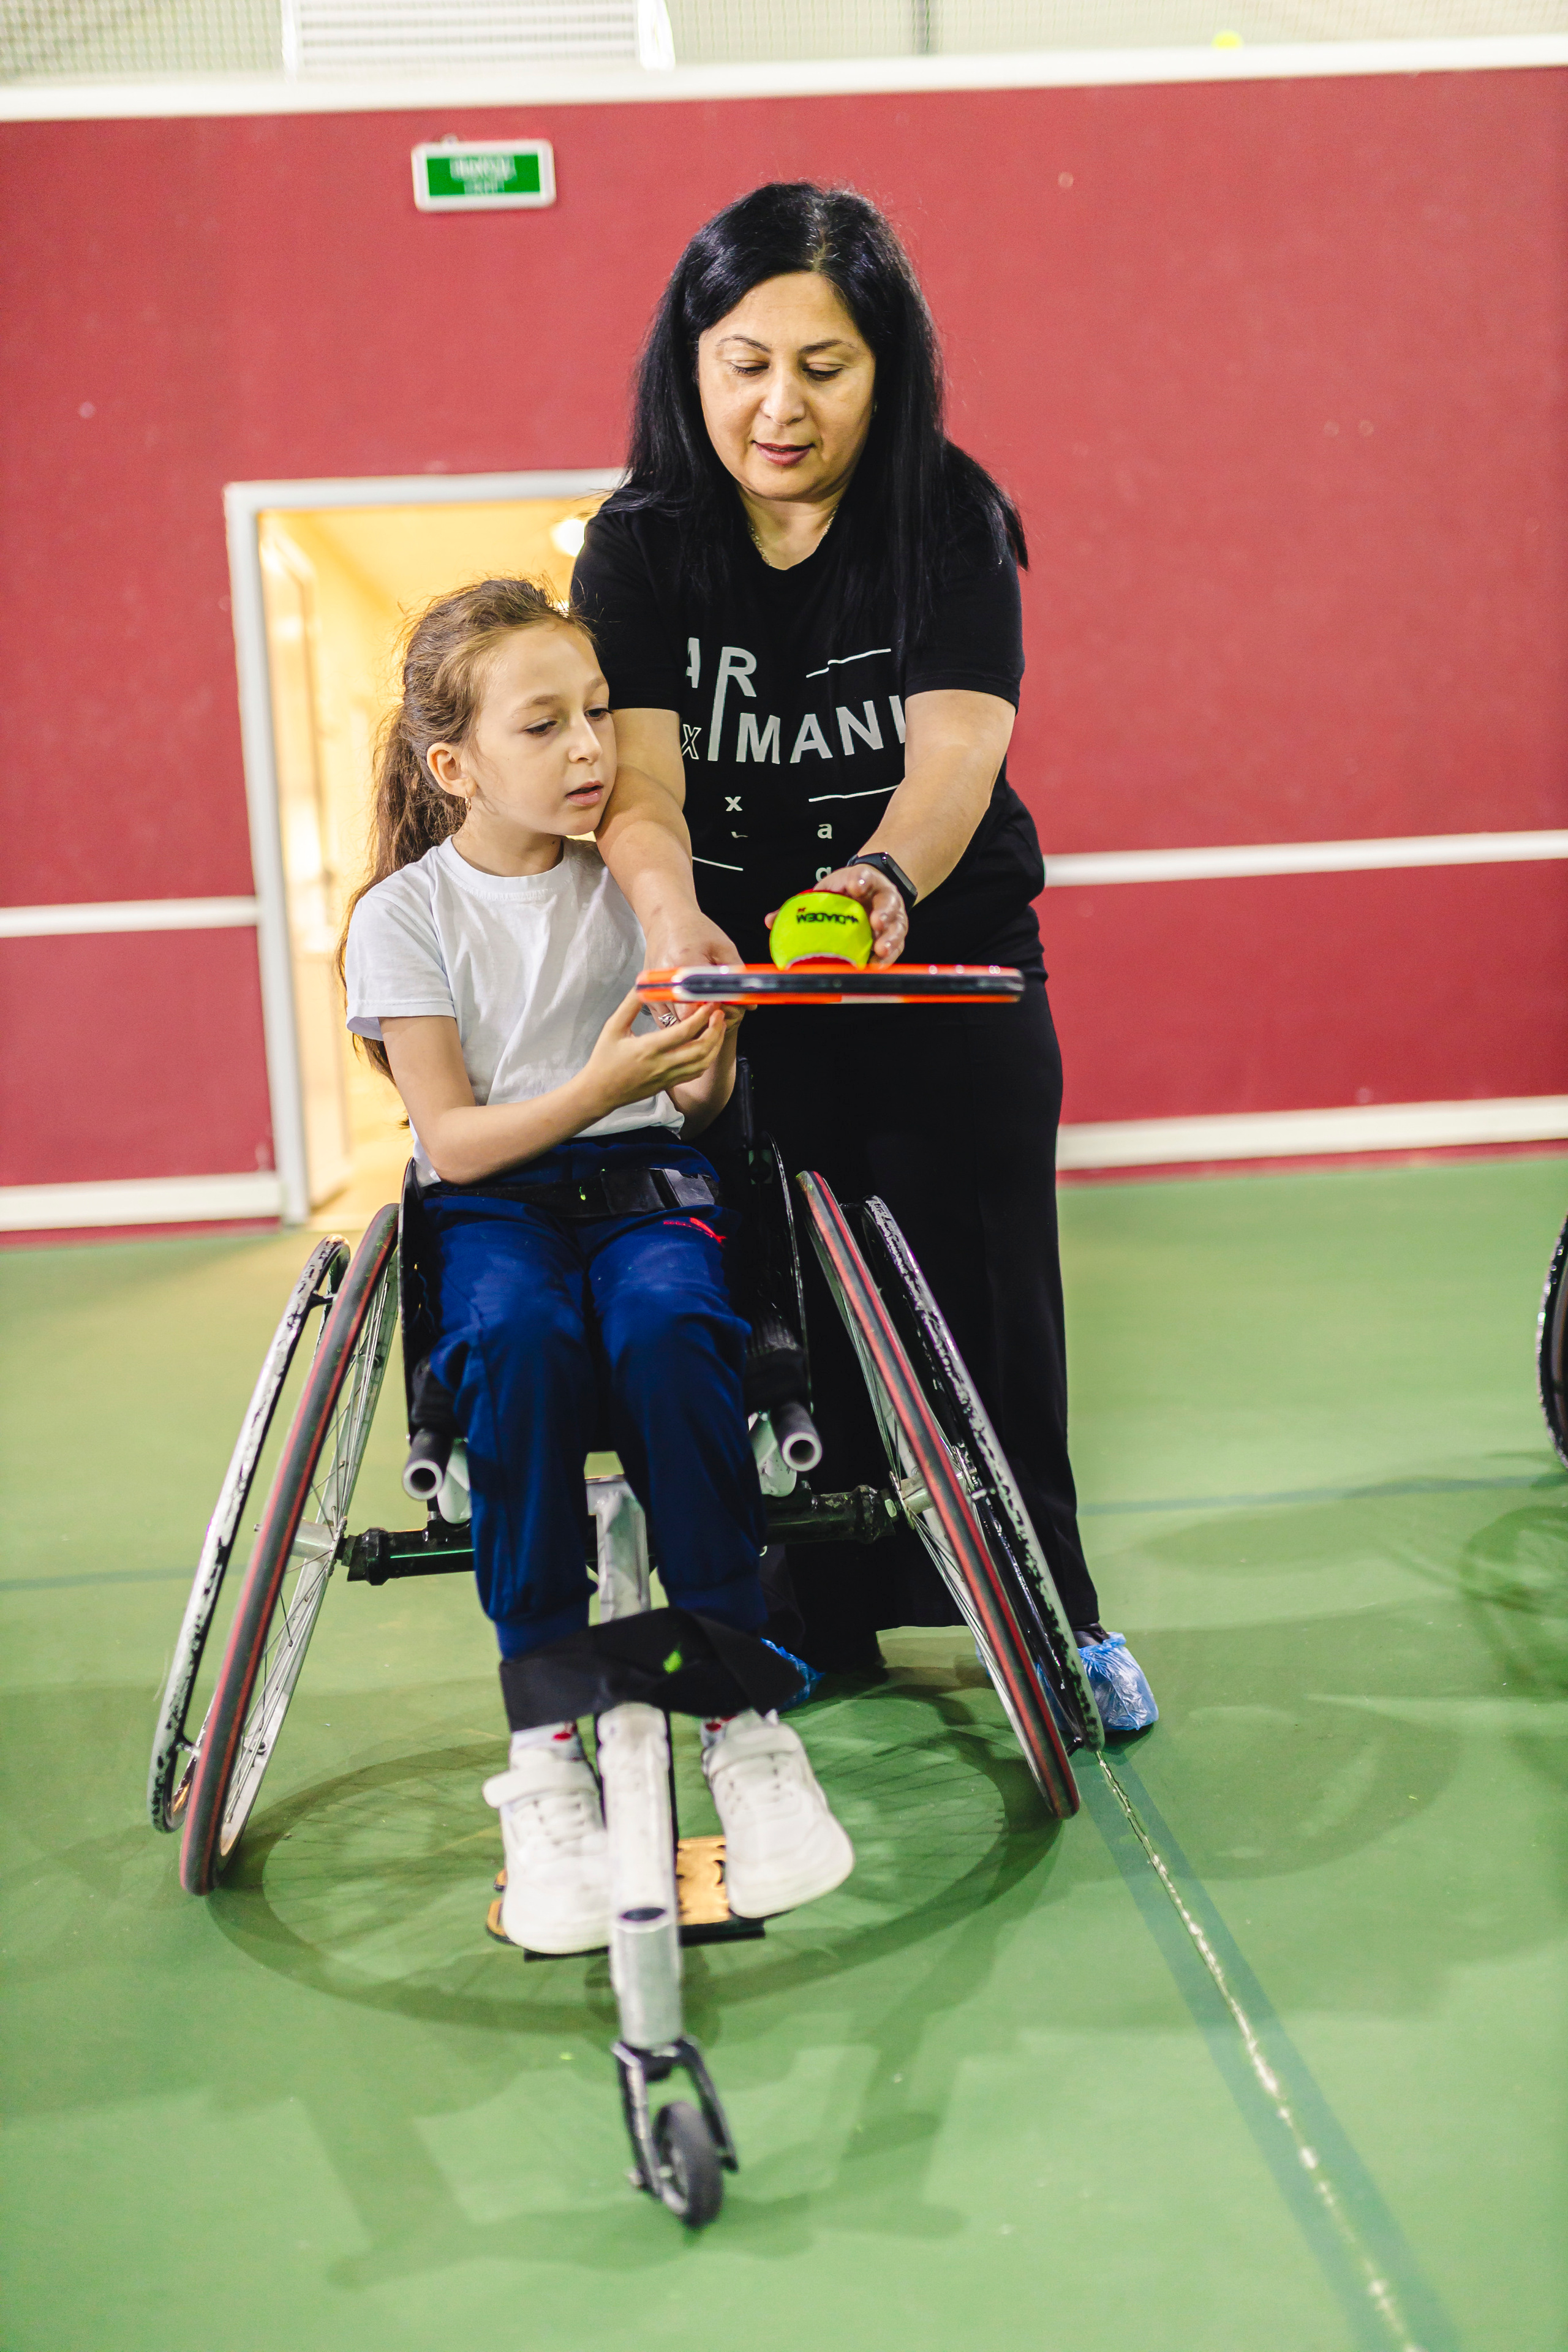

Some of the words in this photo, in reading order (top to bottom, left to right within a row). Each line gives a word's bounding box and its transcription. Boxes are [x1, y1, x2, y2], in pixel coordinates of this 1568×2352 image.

[736, 695, 906, 764] MANI
[817, 824, 832, 839] a
[796, 912, 846, 924] DIADEM
